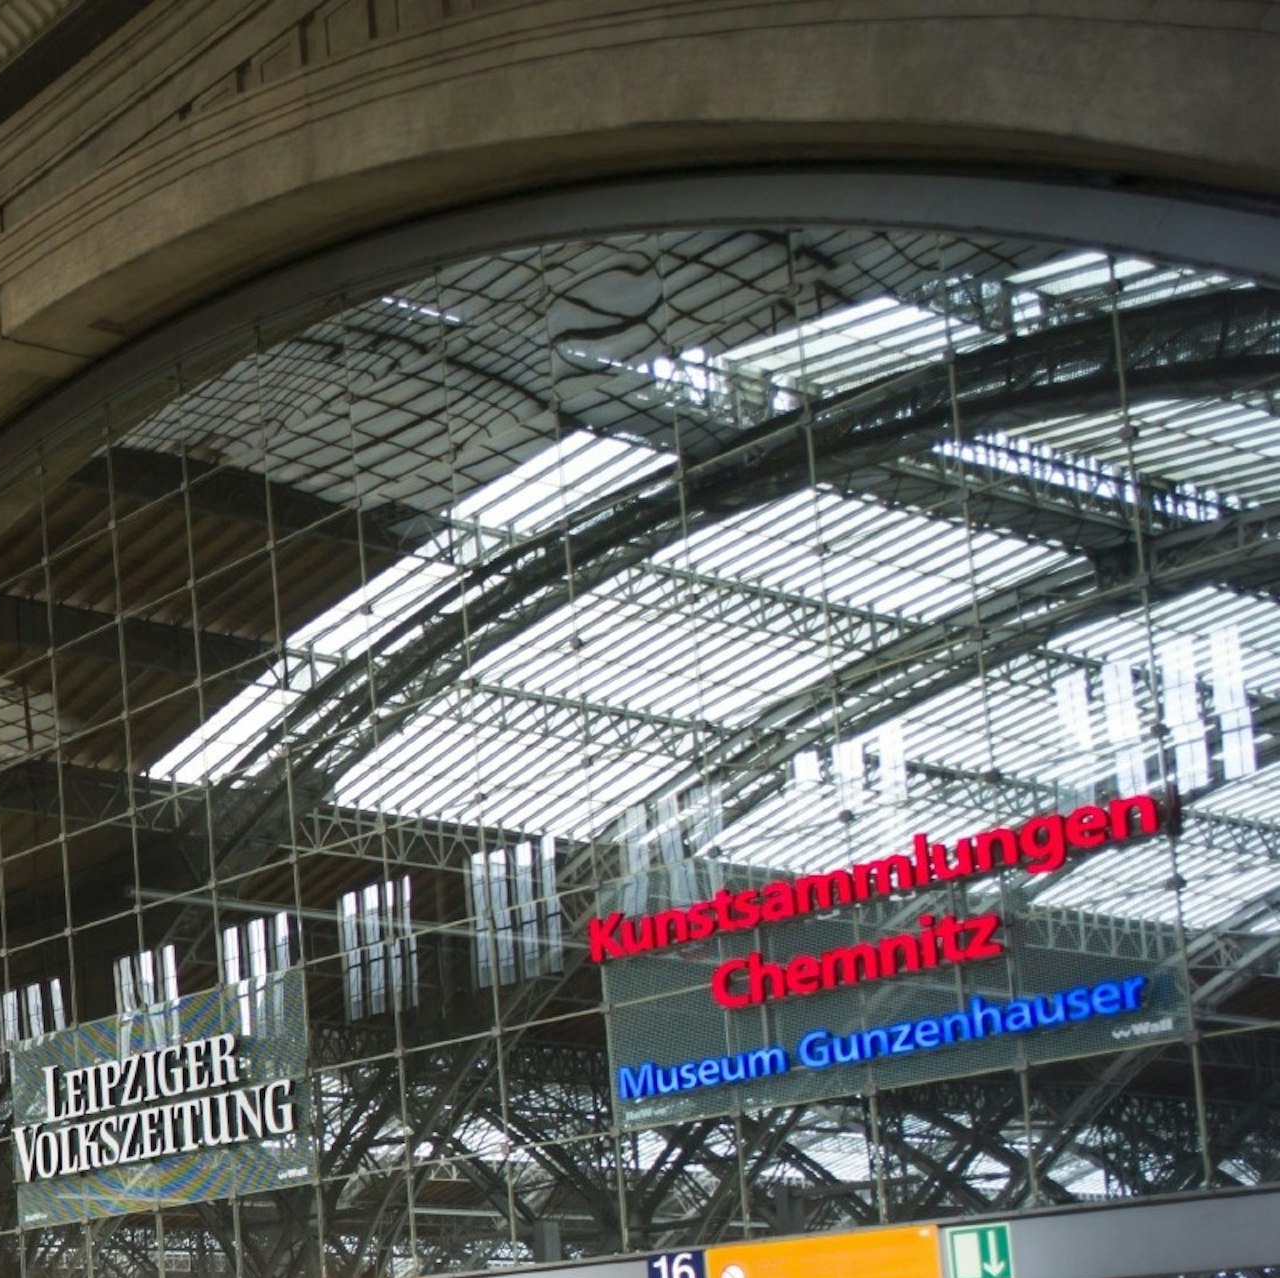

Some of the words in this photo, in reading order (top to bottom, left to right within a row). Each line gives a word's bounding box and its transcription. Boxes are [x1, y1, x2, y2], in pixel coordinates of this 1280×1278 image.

[589, 793, 1158, 963] Kunstsammlungen
[711, 914, 1003, 1009] Chemnitz
[42, 1033, 239, 1122] LEIPZIGER
[618, 1046, 786, 1101] Museum
[798, 971, 1146, 1070] Gunzenhauser
[12, 1079, 293, 1183] VOLKSZEITUNG
